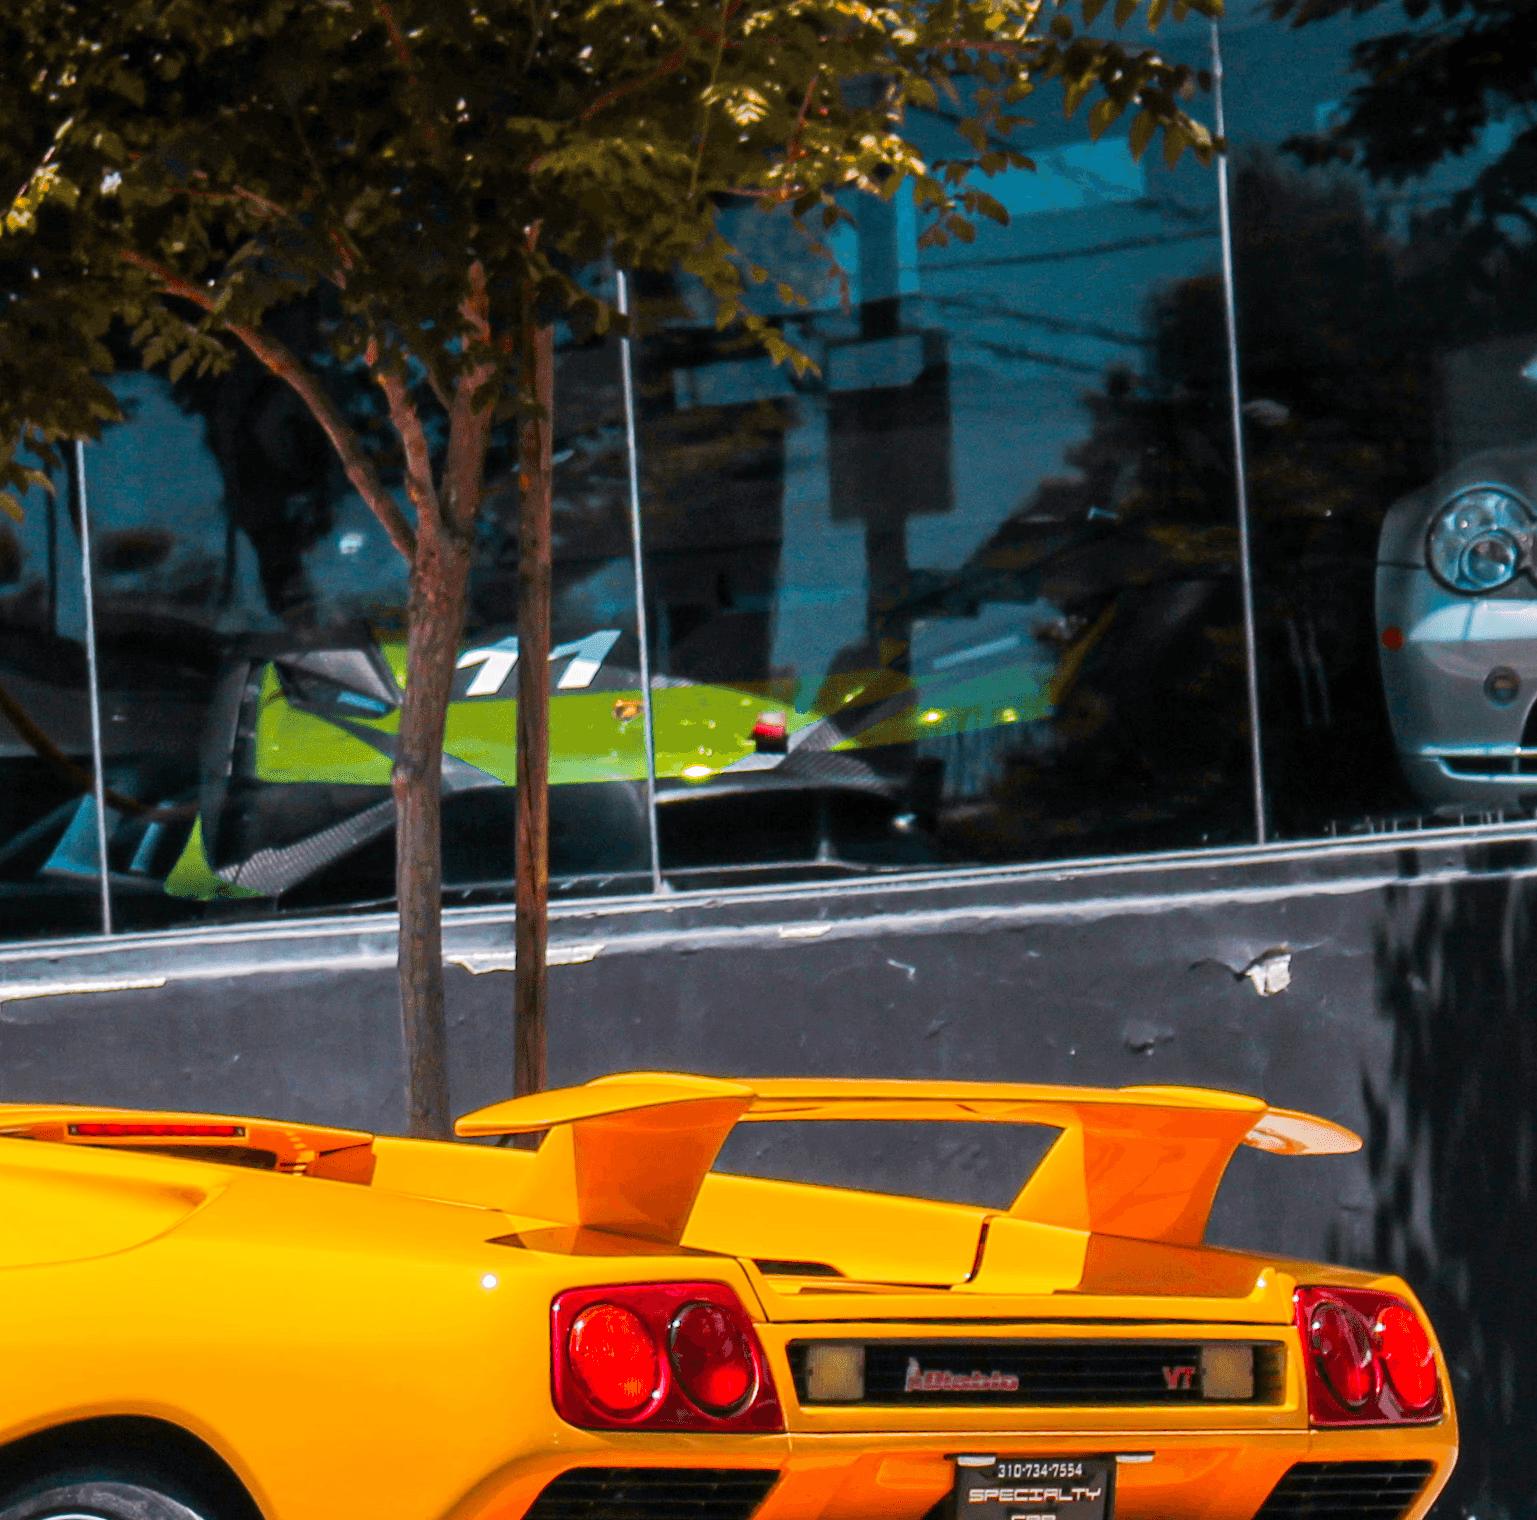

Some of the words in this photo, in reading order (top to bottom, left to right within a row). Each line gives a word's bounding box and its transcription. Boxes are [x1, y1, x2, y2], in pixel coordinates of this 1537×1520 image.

[455, 629, 622, 697] 11
[1163, 1367, 1195, 1389] VT
[969, 1488, 1101, 1502] SPECIALTY
